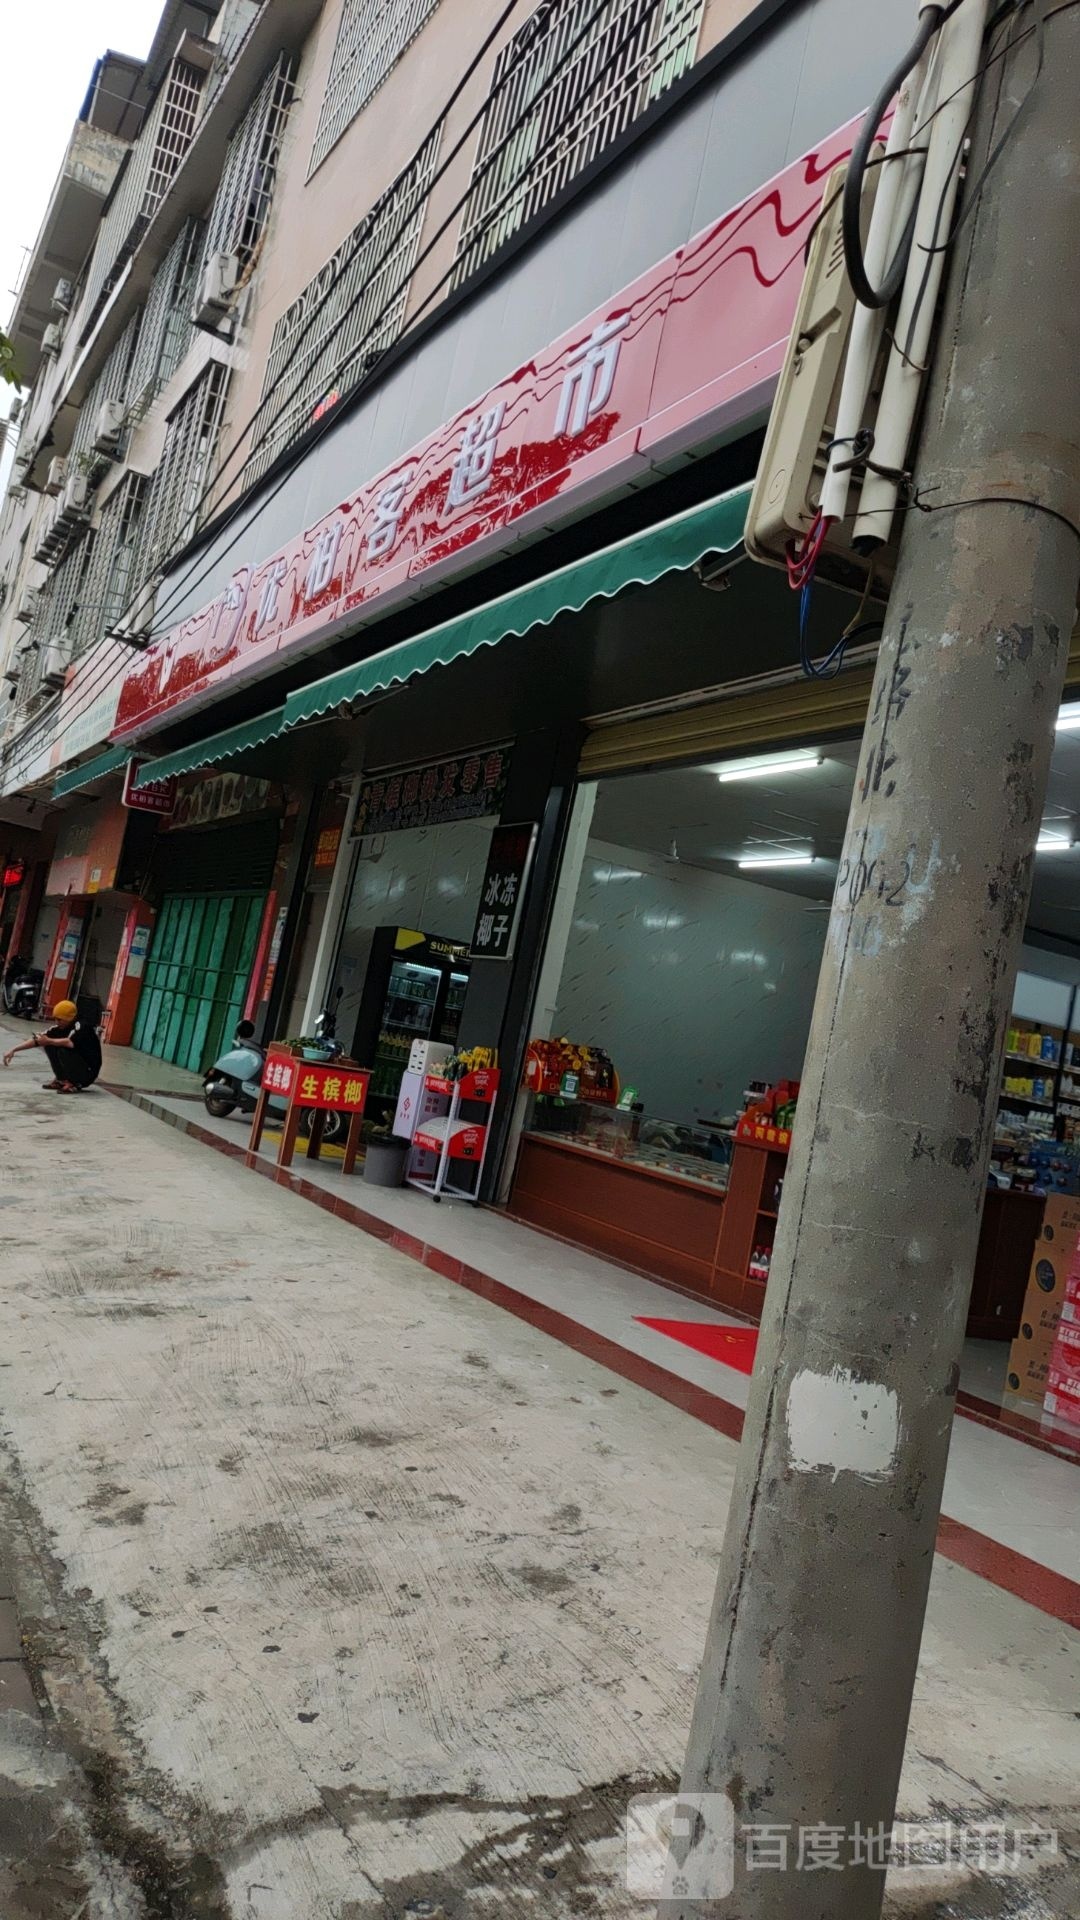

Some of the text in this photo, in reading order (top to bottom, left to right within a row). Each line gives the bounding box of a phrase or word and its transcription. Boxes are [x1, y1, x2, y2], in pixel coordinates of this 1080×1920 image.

[255, 313, 631, 632] 优柏客超市
[484, 872, 518, 907] 冰冻
[476, 912, 509, 948] 椰子
[264, 1062, 293, 1092] 生槟榔
[300, 1074, 364, 1105] 生槟榔
